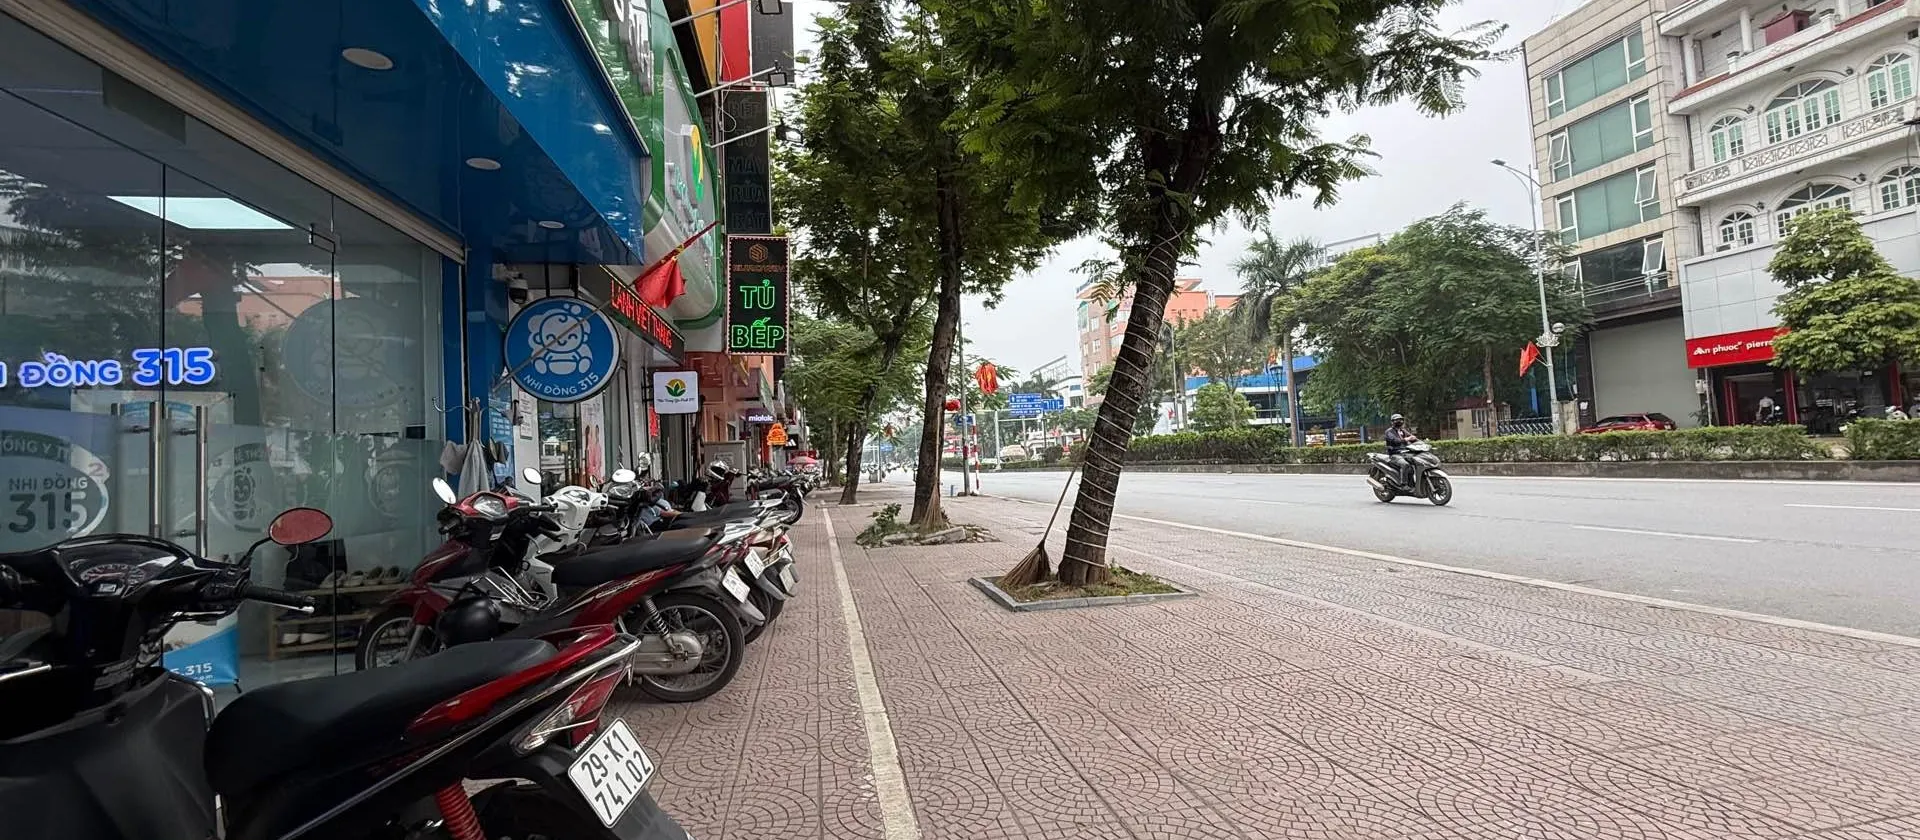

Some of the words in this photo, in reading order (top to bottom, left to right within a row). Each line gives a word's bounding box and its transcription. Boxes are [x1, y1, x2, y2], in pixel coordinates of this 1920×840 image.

[739, 279, 775, 310] TỦ
[731, 316, 785, 349] BẾP
[17, 351, 123, 387] ĐỒNG
[131, 347, 215, 386] 315
[523, 374, 542, 391] NHI
[543, 384, 577, 396] ĐỒNG
[577, 372, 599, 391] 315
[8, 477, 37, 491] NHI
[43, 472, 88, 491] ĐỒNG
[8, 491, 88, 533] 315
[185, 662, 213, 677] 315
[581, 729, 631, 789] 29-K1
[594, 750, 652, 821] 741.02
